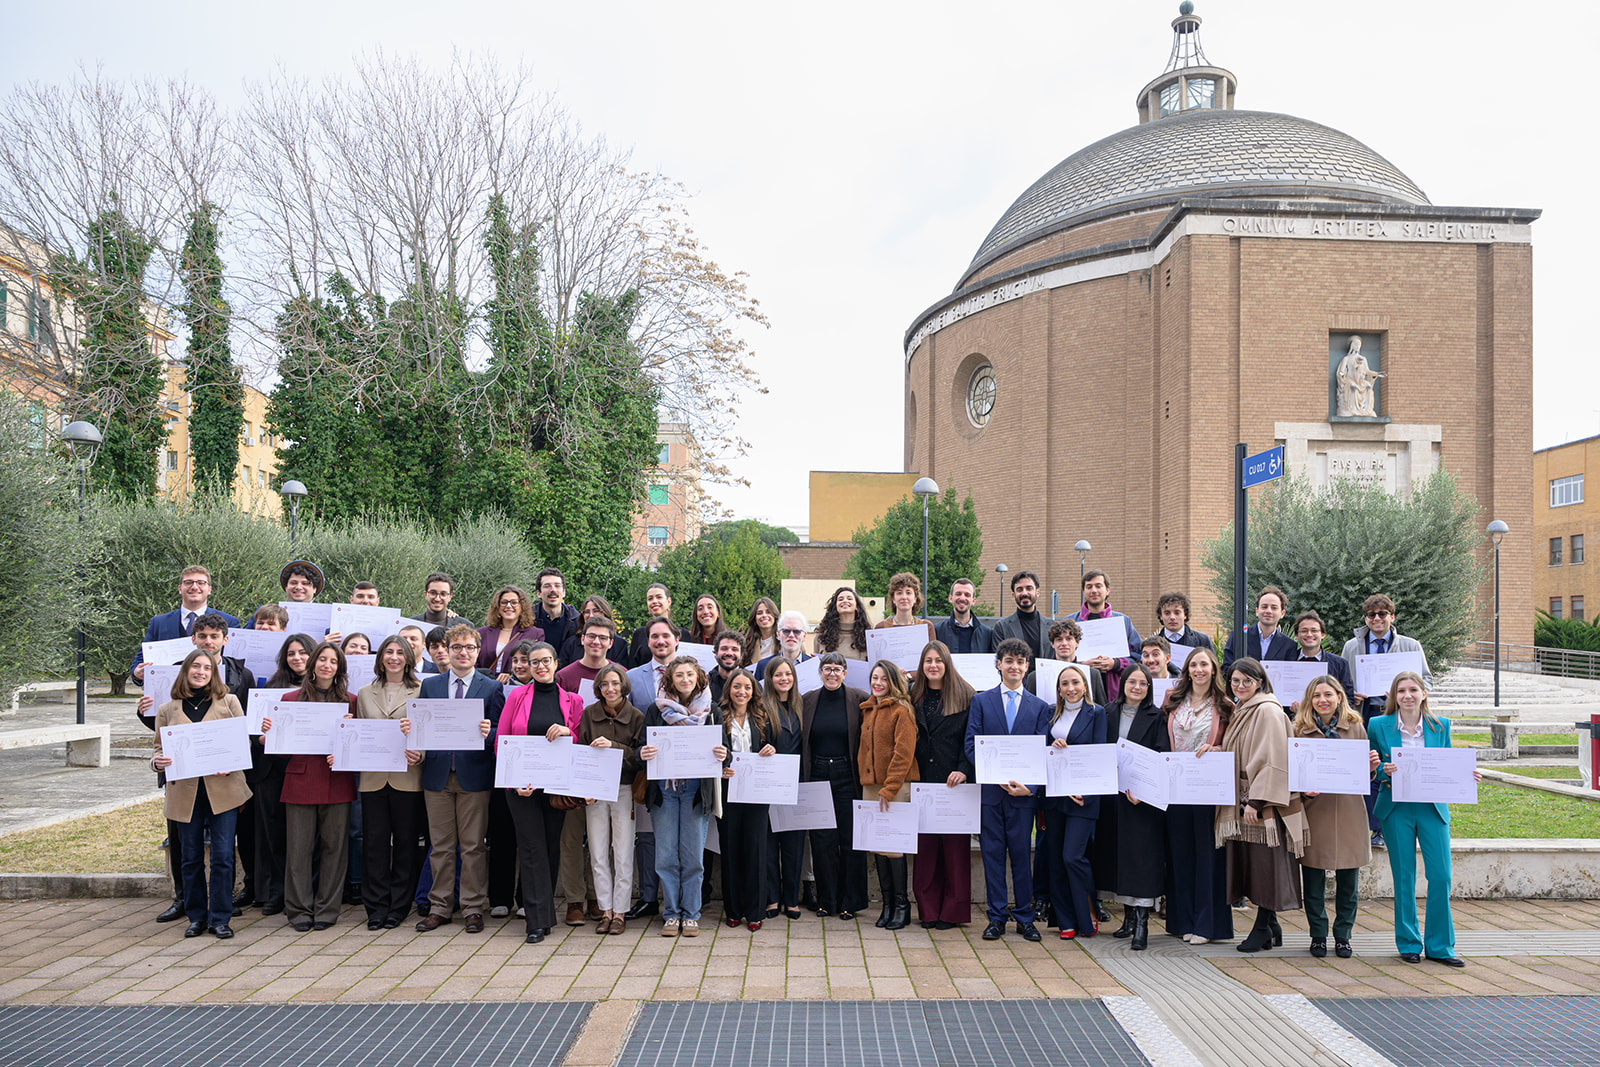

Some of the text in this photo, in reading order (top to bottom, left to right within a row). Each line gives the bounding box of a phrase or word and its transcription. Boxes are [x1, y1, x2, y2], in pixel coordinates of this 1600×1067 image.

[1223, 218, 1497, 240] OMNIVM ARTIFEX SAPIENTIA
[1248, 462, 1266, 475] CU 017
